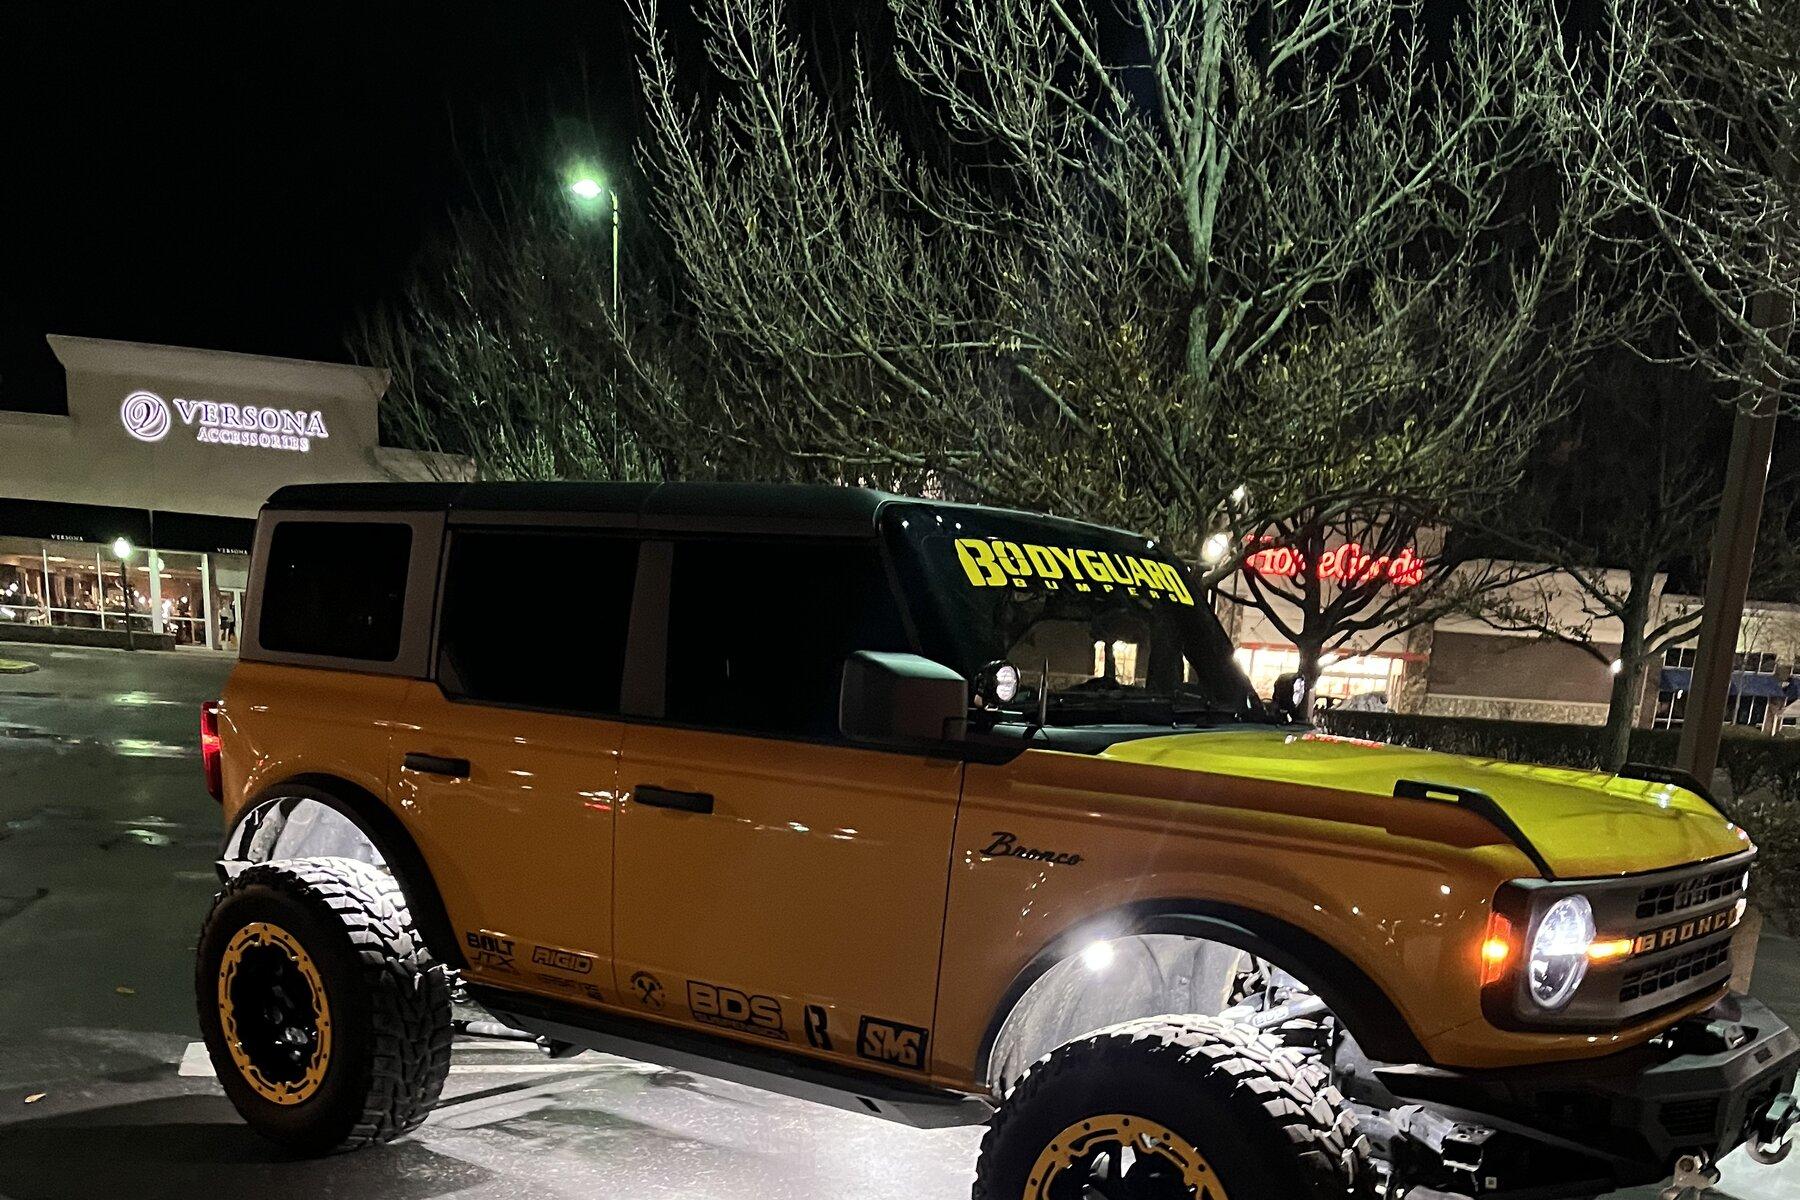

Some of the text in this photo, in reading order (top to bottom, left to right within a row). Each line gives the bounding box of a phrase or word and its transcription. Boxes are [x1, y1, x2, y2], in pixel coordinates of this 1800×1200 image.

[172, 398, 328, 438] VERSONA
[197, 426, 310, 451] ACCESSORIES
[51, 534, 84, 542] VERSONA
[216, 547, 248, 555] VERSONA
[955, 538, 1194, 606] BODYGUARD
[1014, 578, 1178, 602] BUMPERS
[979, 831, 1085, 866] Bronco
[1634, 905, 1741, 954] BRONCO
[532, 945, 593, 975] RIGID
[687, 979, 784, 1032] BDS
